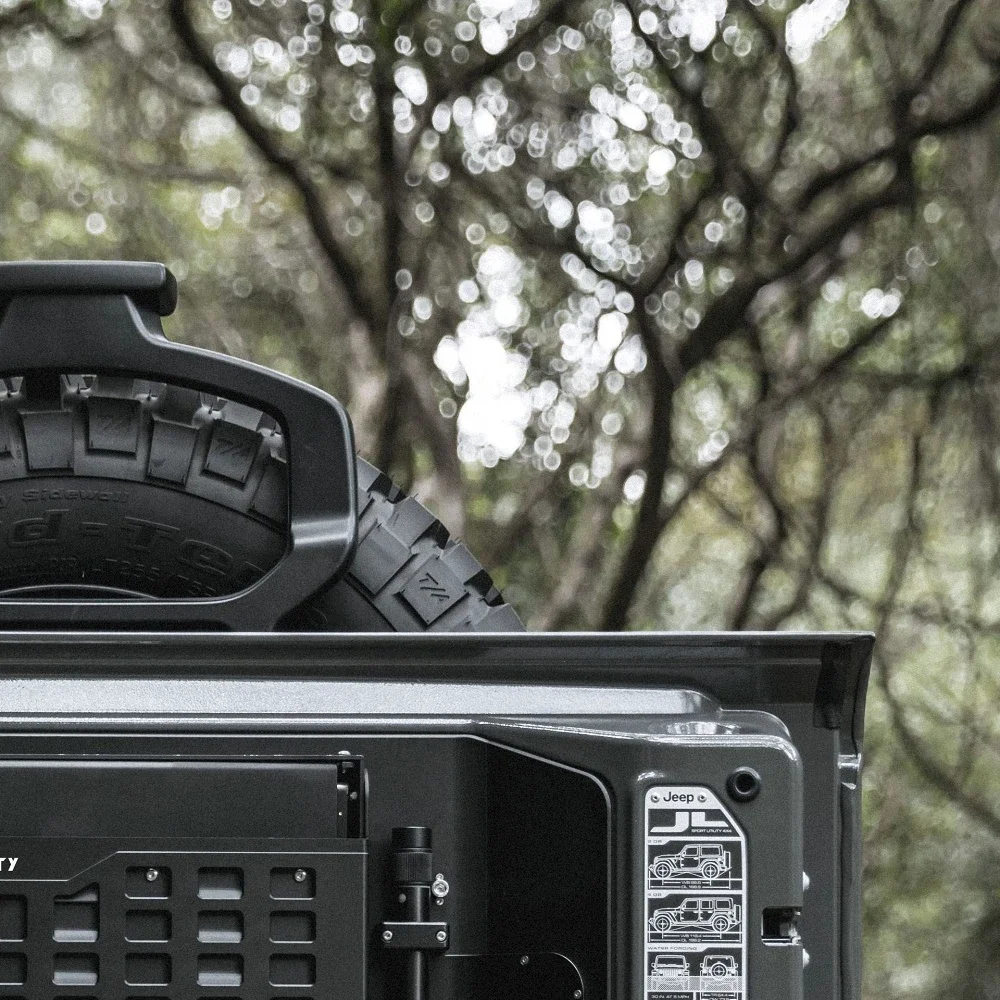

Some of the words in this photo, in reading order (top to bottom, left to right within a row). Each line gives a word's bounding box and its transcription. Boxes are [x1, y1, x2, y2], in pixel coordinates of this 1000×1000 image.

[21, 487, 131, 504] Sidewall
[663, 791, 694, 804] Jeep
[650, 811, 729, 833] JL
